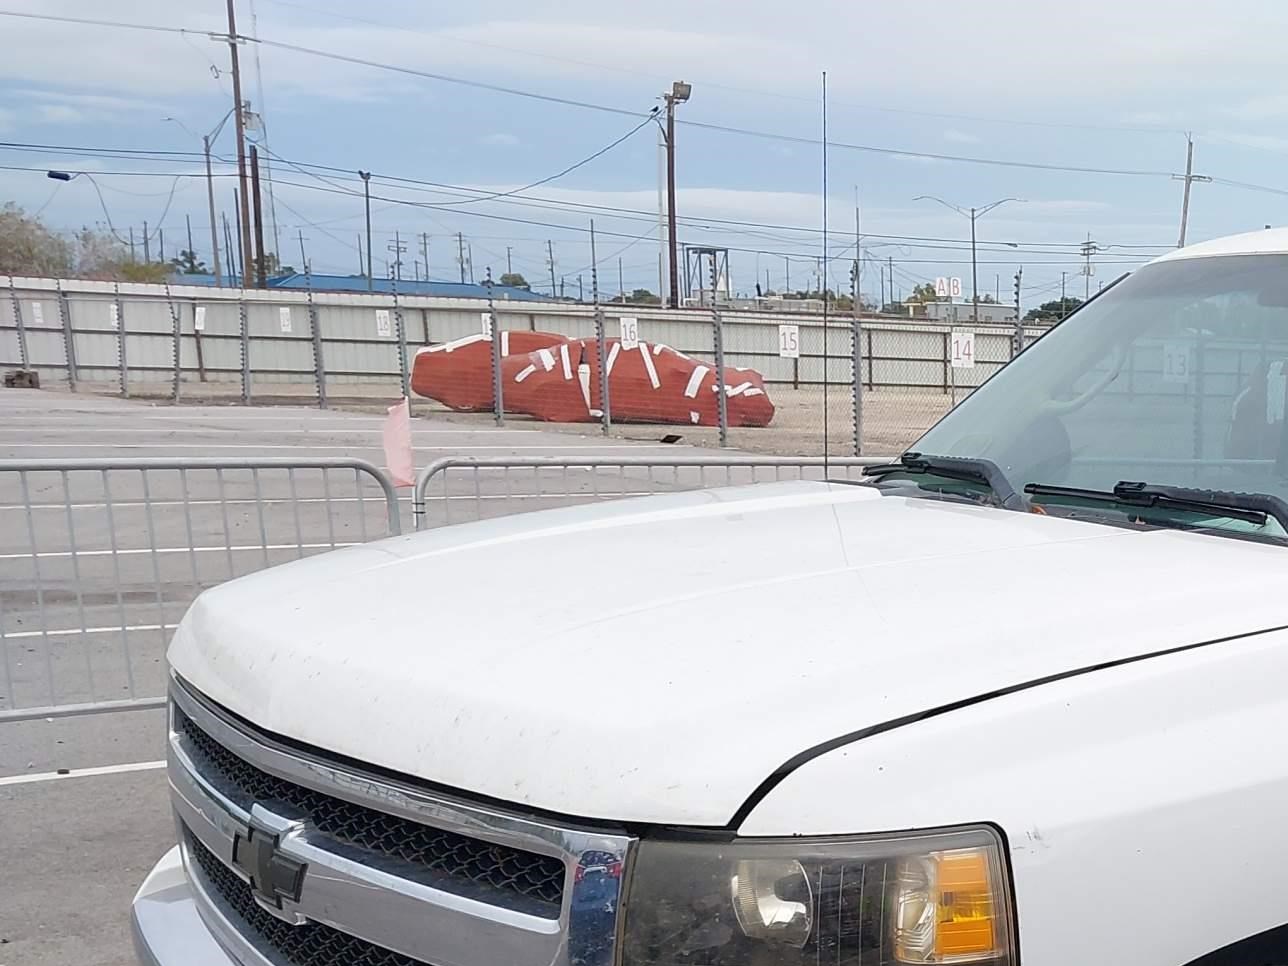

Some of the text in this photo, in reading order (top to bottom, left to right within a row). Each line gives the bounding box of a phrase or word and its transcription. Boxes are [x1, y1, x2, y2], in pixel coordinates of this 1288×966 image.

[938, 279, 960, 296] A B
[622, 324, 637, 342] 16
[781, 331, 797, 350] 15
[953, 339, 973, 360] 14
[1166, 353, 1188, 370] 13
